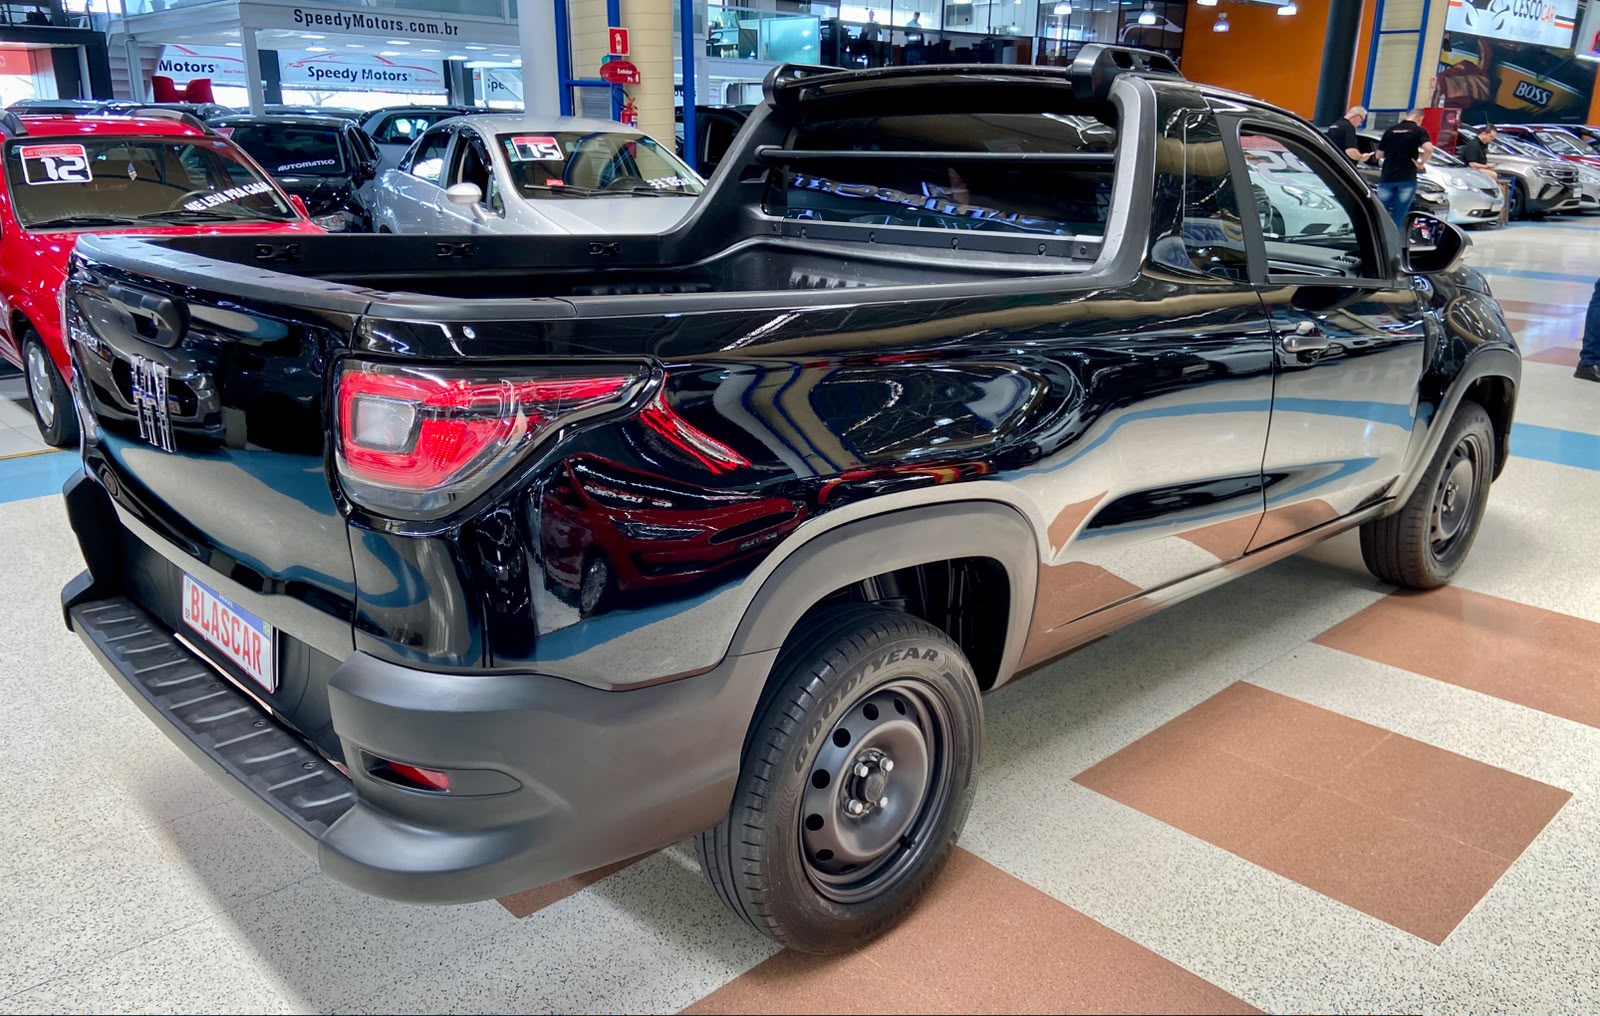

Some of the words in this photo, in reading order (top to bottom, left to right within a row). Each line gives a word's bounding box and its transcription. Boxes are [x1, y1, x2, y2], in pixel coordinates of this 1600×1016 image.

[294, 9, 459, 36] SpeedyMotors.com.br
[159, 60, 215, 73] Motors
[308, 66, 358, 82] Speedy
[362, 68, 408, 82] Motors
[1515, 81, 1549, 105] BOSS
[527, 144, 562, 159] 15
[41, 155, 86, 181] 12
[190, 584, 262, 676] BLASCAR
